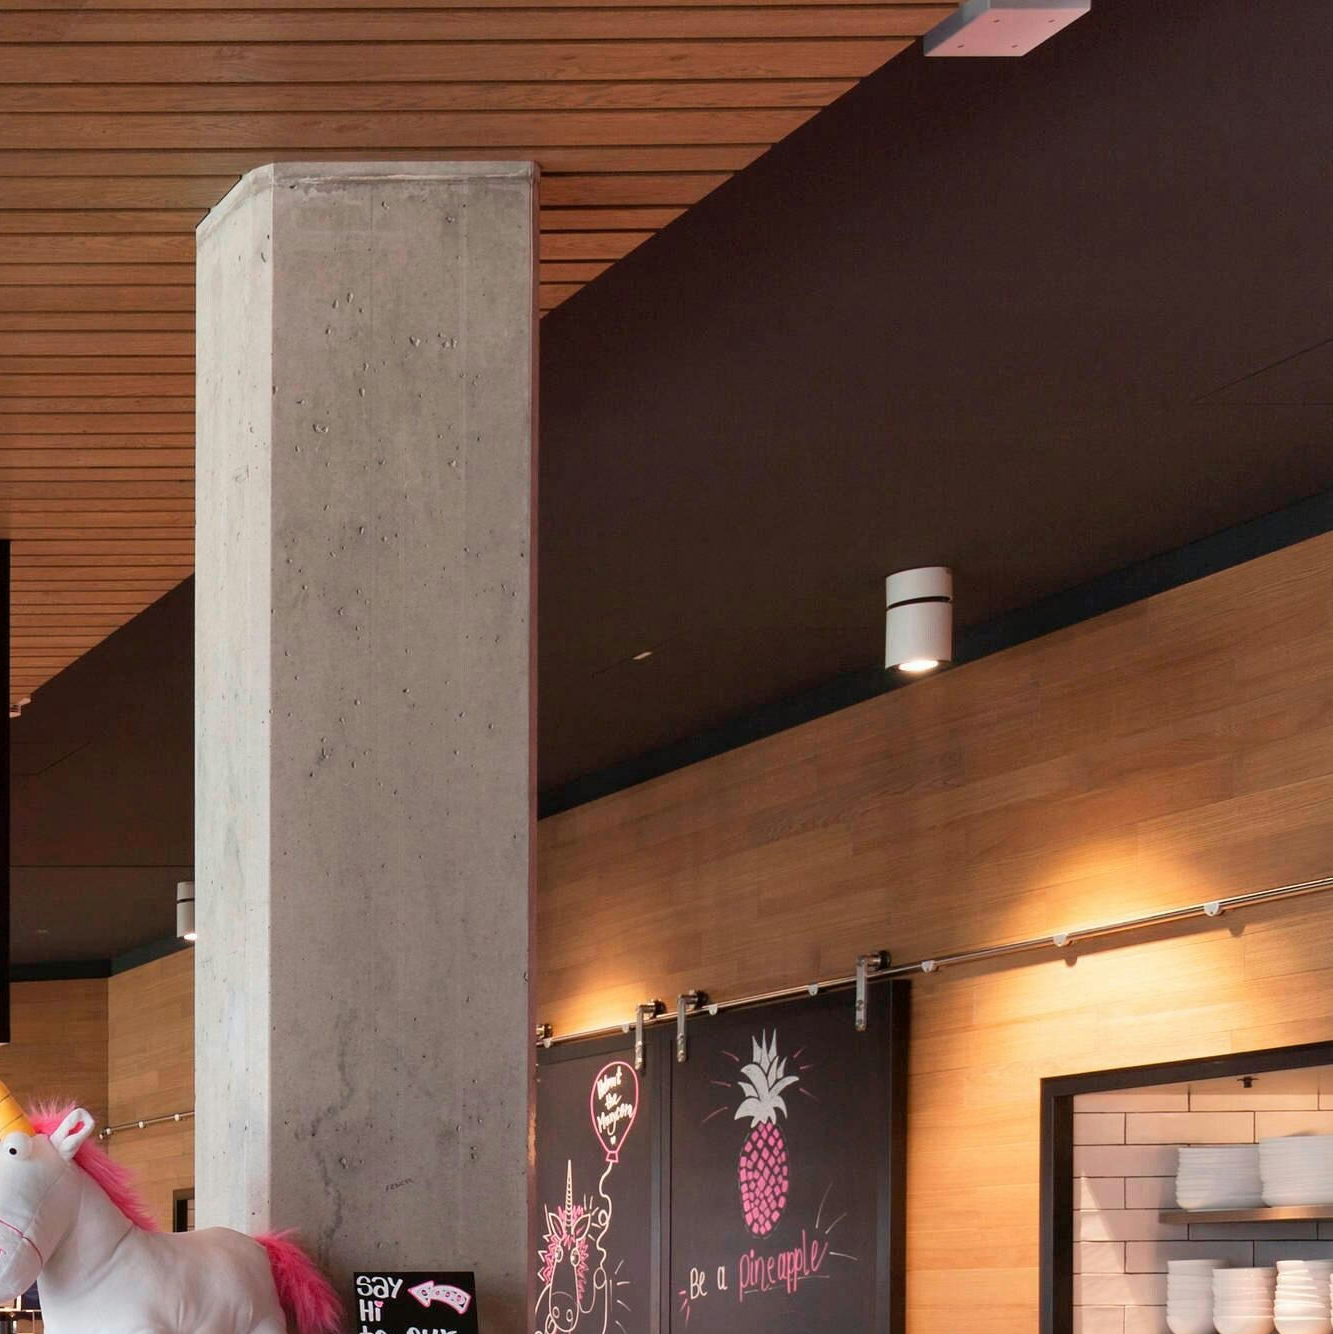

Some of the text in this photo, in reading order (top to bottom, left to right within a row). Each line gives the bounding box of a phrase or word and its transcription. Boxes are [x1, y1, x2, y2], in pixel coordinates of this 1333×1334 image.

[690, 1230, 829, 1302] Be a pineapple
[359, 1299, 384, 1322] Hi
